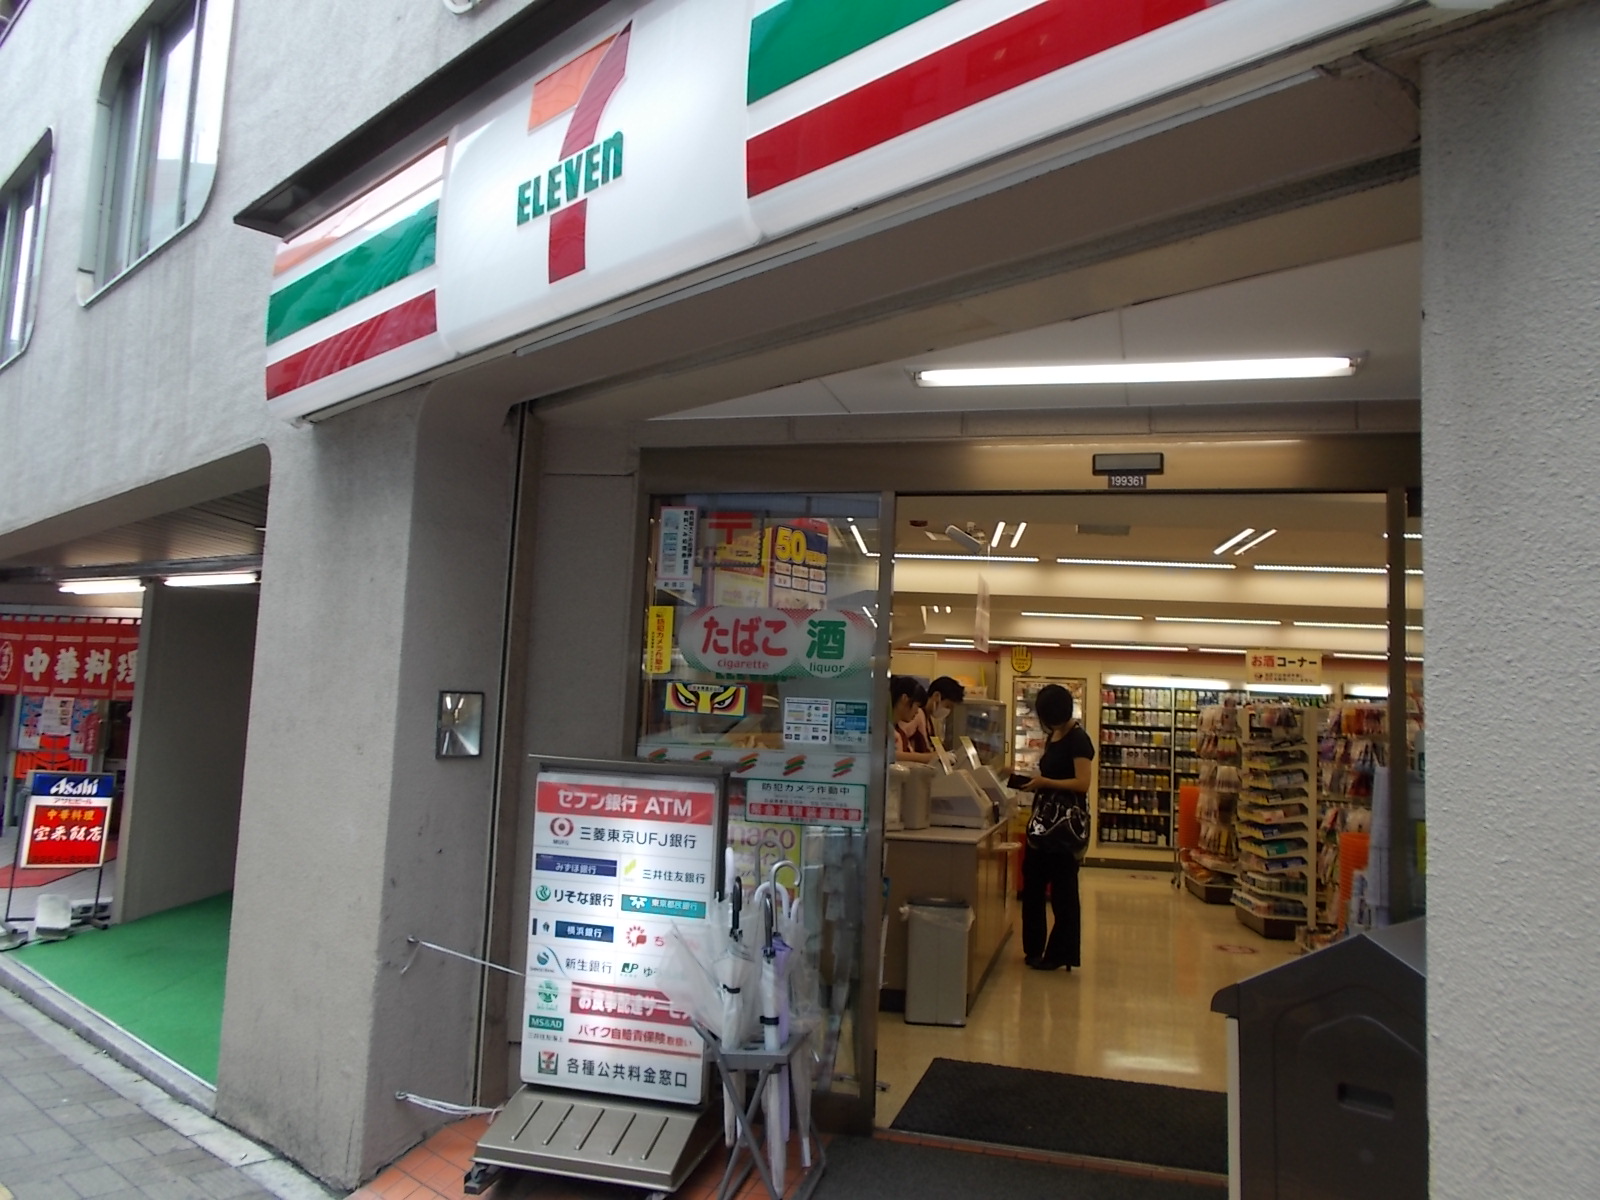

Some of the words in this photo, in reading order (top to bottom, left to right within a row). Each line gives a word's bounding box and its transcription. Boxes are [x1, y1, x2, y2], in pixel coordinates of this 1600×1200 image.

[527, 19, 633, 284] 7
[1111, 475, 1144, 486] 199361
[775, 525, 807, 563] 50
[702, 616, 788, 656] たばこ
[806, 619, 847, 660] 酒
[717, 659, 769, 670] cigarette
[809, 662, 844, 674] liquor
[1252, 655, 1317, 668] お酒コーナー
[50, 778, 99, 795] Asahi
[762, 783, 850, 795] 防犯カメラ作動中
[644, 797, 692, 816] ATM
[580, 827, 697, 849] 三菱東京UFJ銀行
[555, 862, 597, 874] みずほ銀行
[643, 869, 706, 884] 三井住友銀行
[554, 889, 614, 907] りそな銀行
[567, 926, 603, 938] 横浜銀行
[565, 957, 612, 974] 新生銀行
[566, 1058, 688, 1088] 各種公共料金窓口
